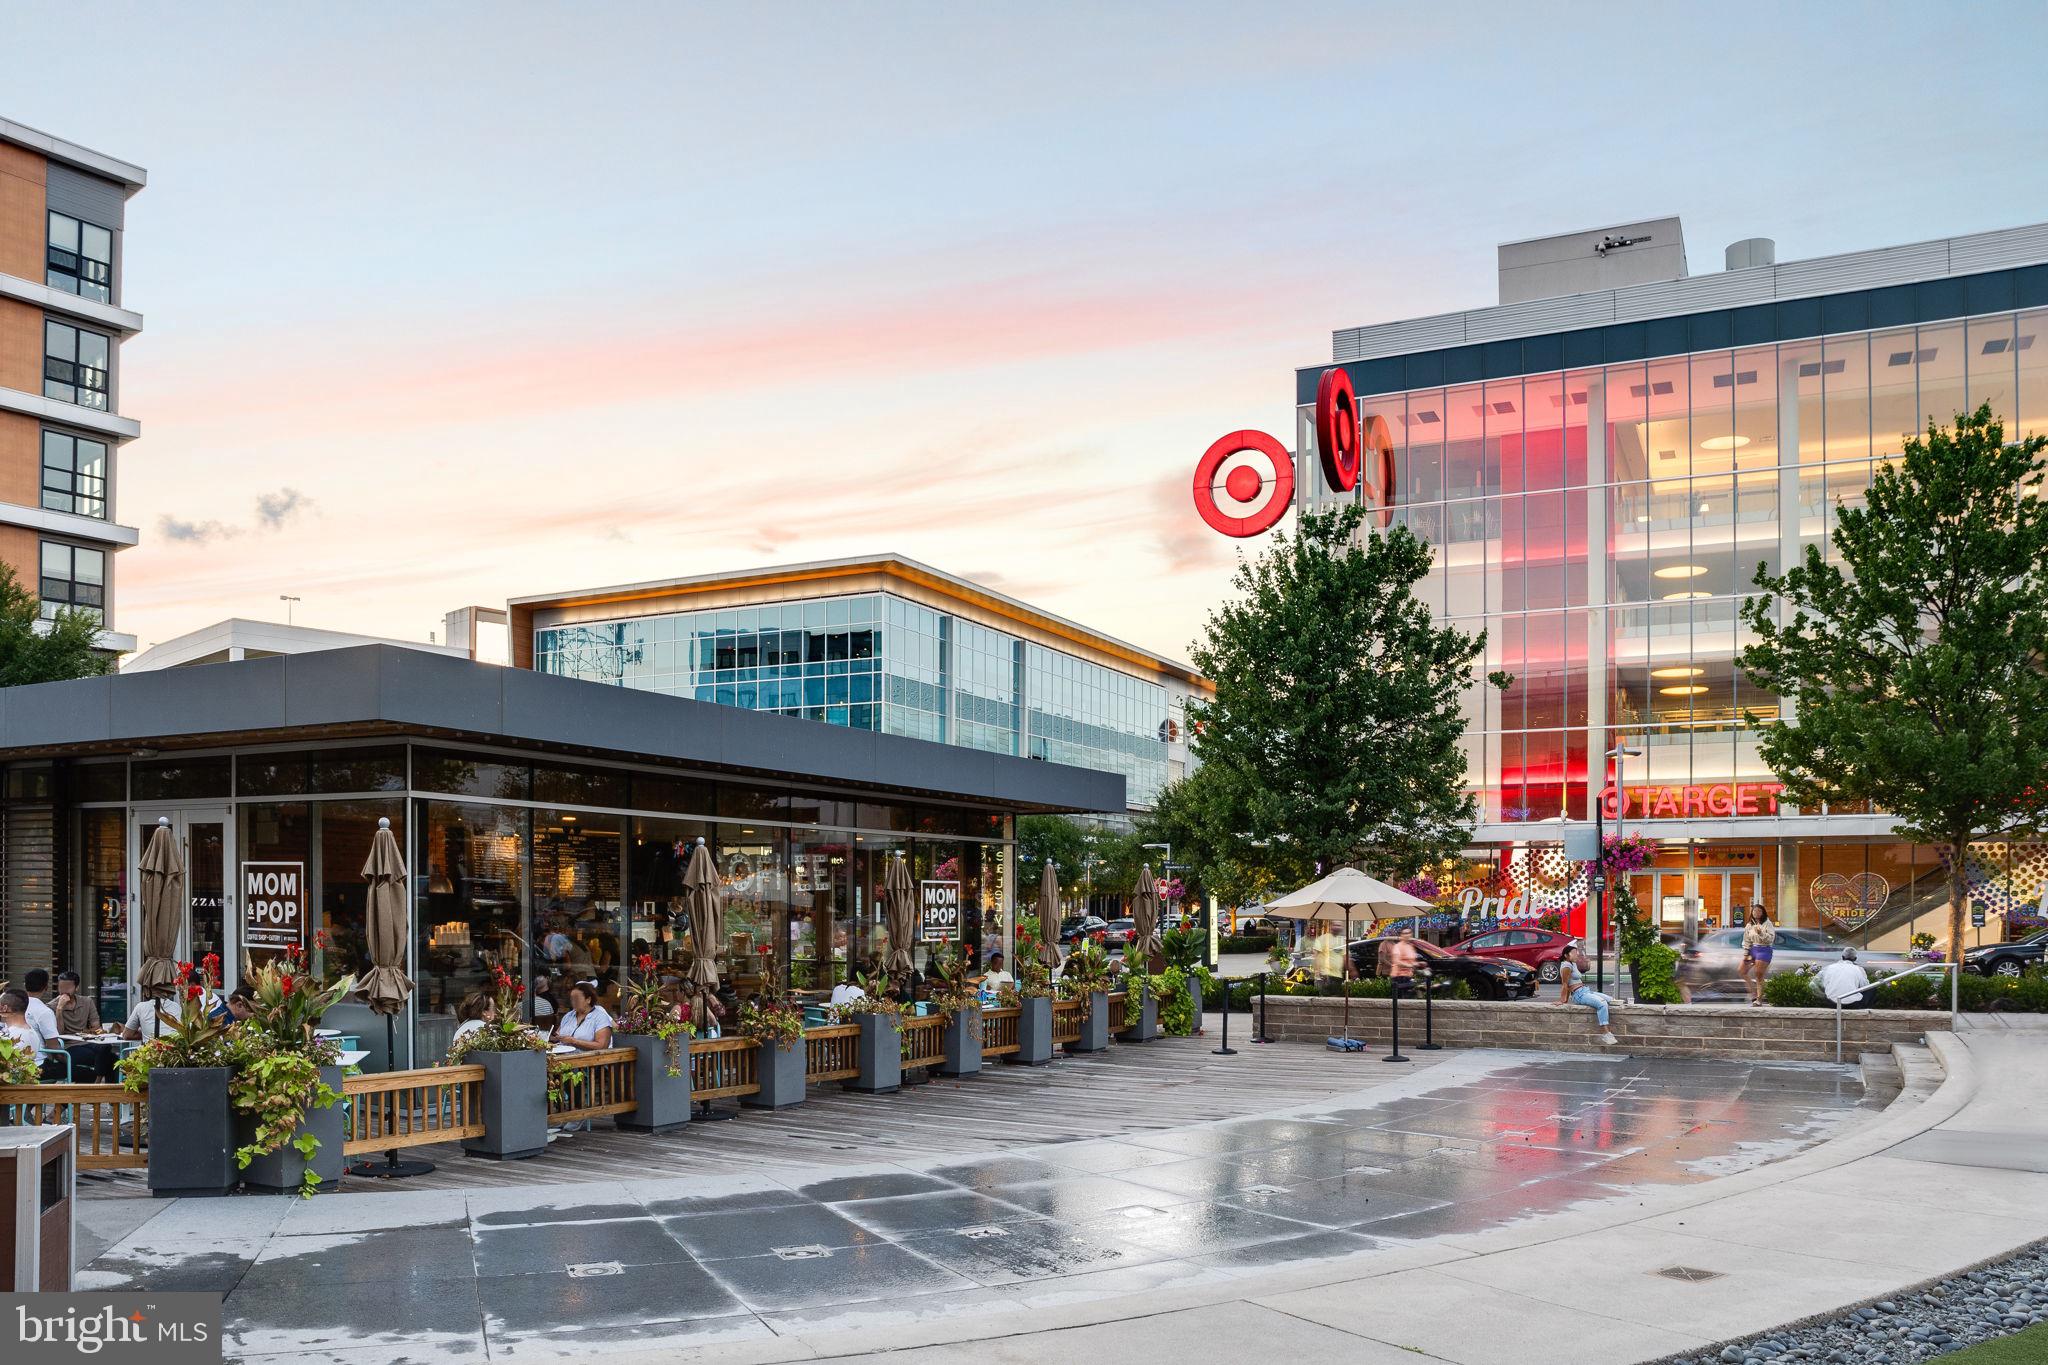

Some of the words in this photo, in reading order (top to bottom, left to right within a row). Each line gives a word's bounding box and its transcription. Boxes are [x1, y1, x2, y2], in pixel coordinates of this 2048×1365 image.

[1634, 784, 1786, 816] TARGET
[718, 849, 831, 891] OFEE
[247, 872, 297, 896] MOM
[925, 888, 956, 904] MOM
[256, 900, 297, 924] POP
[1457, 886, 1544, 920] Pride
[1832, 908, 1866, 918] PRIDE
[930, 907, 957, 924] POP
